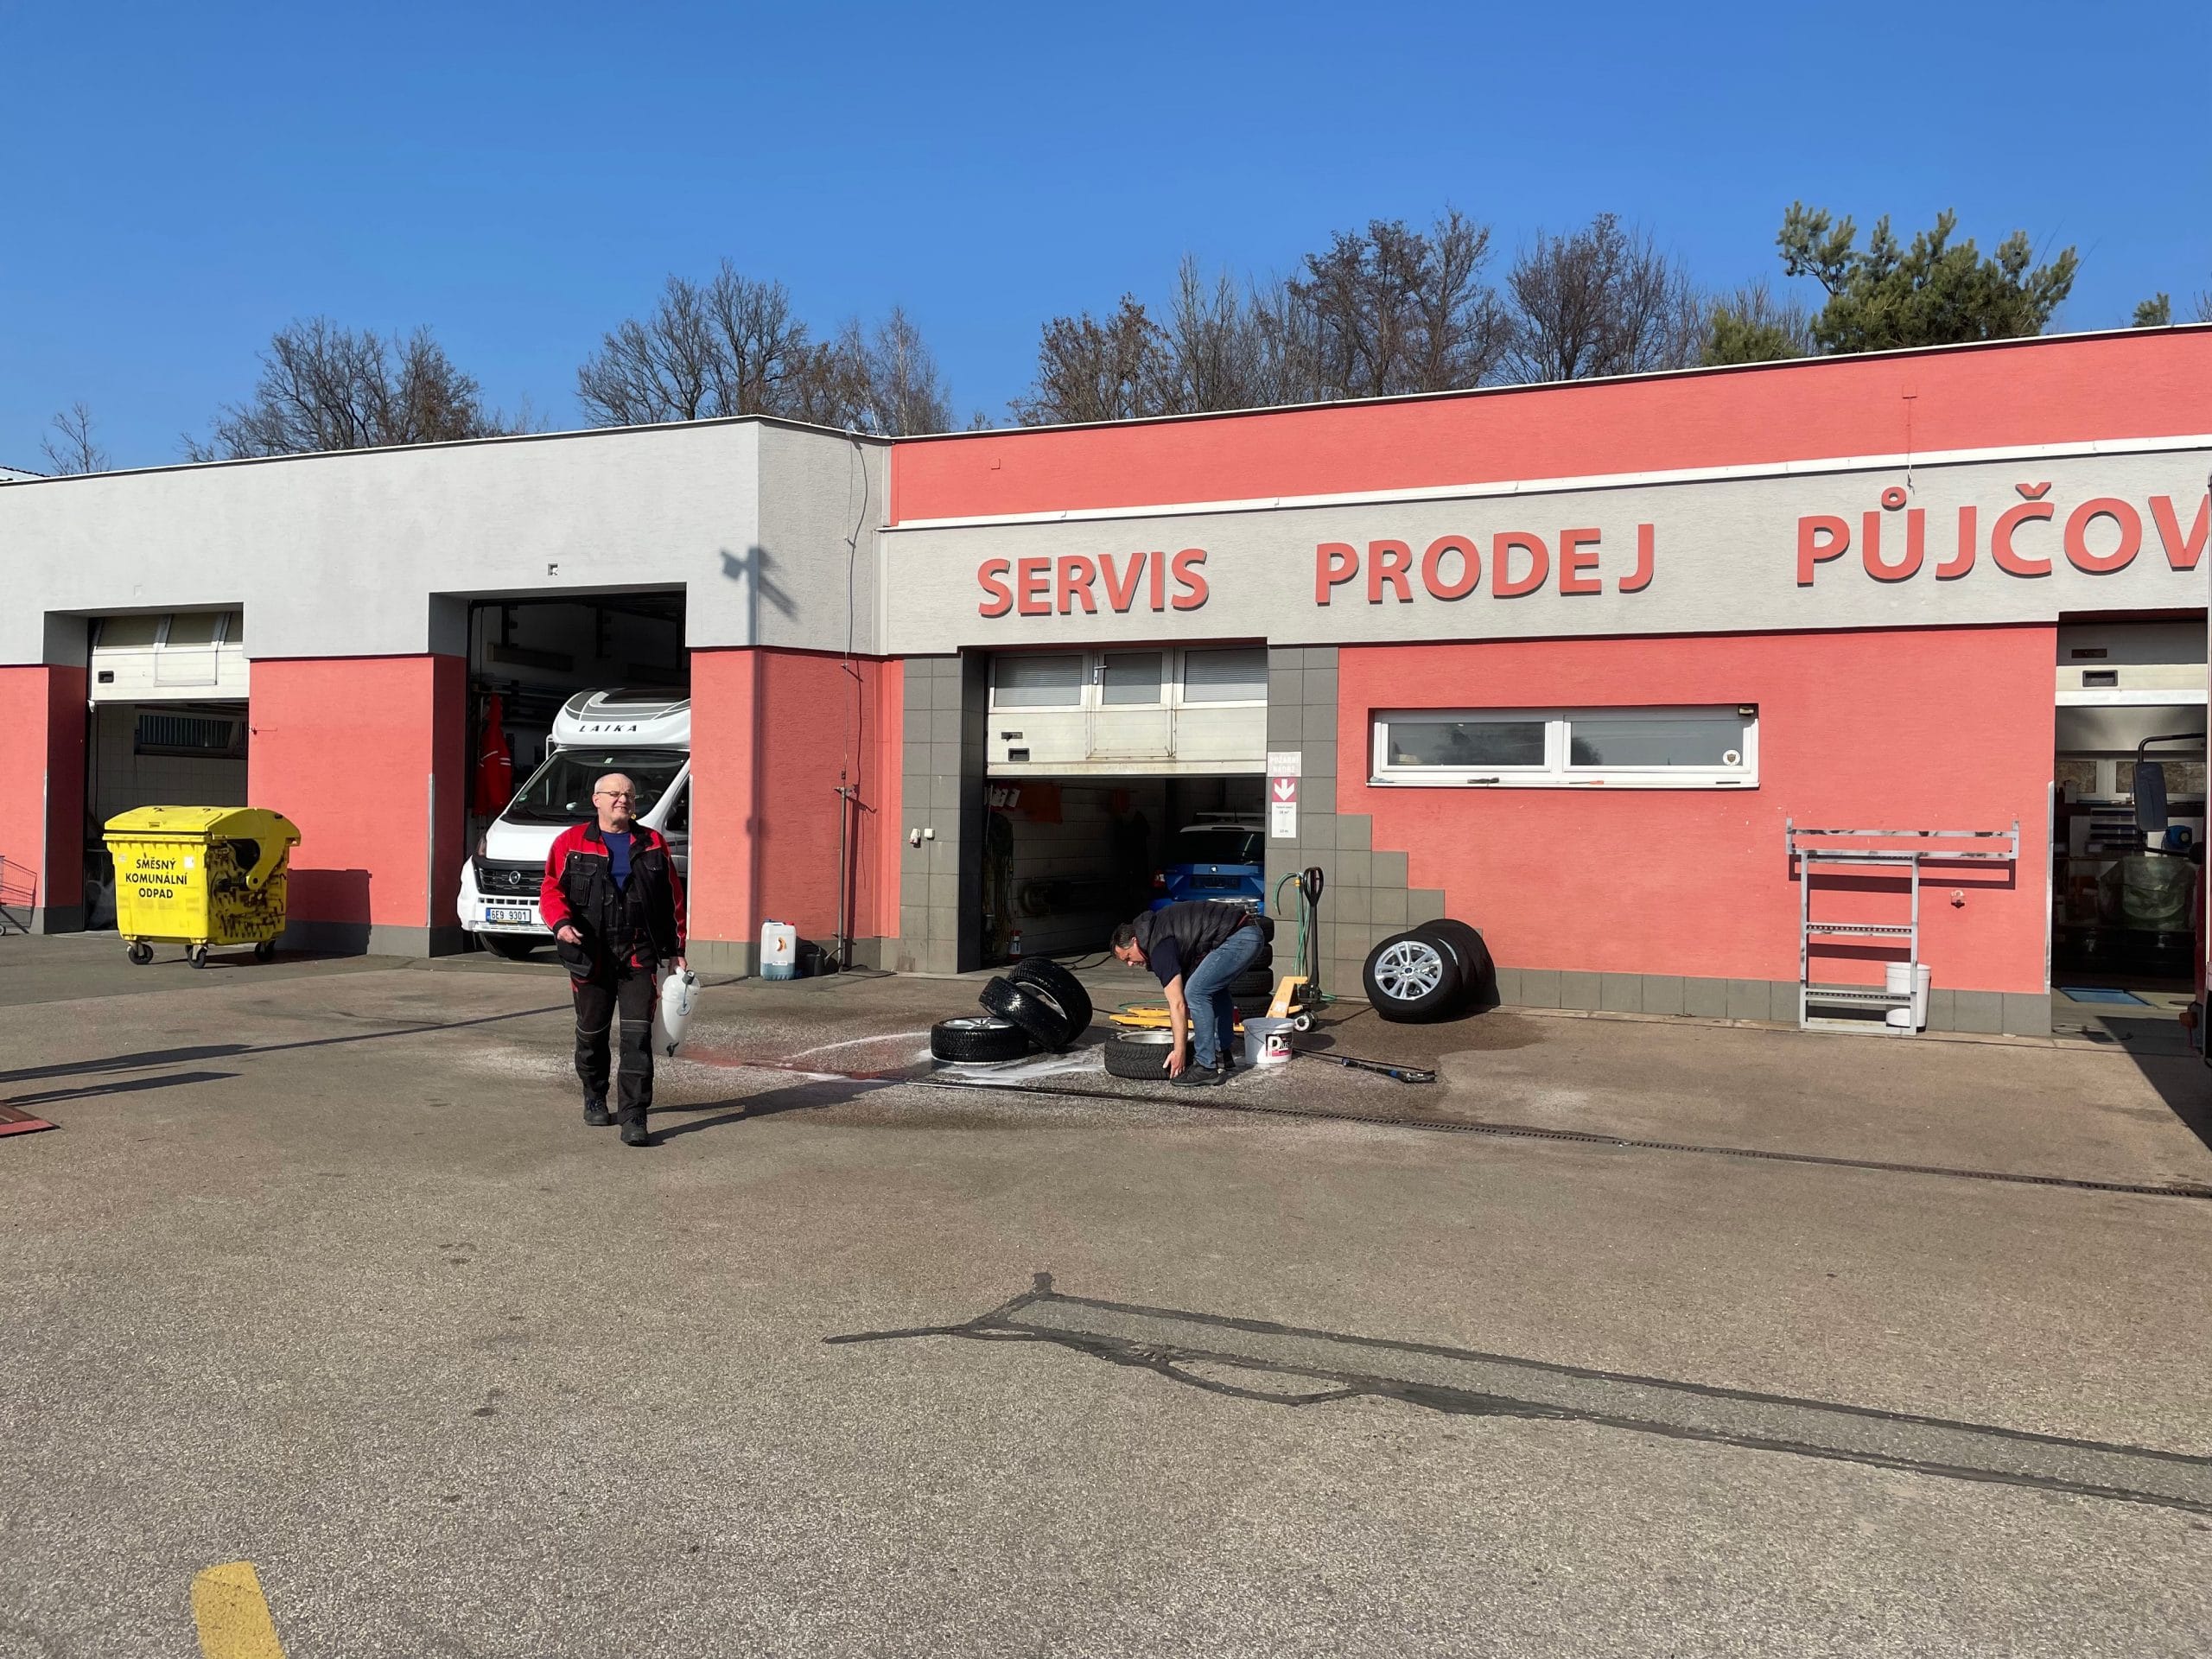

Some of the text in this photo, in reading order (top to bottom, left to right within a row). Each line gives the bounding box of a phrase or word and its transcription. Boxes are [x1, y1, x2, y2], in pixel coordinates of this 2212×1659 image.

[977, 548, 1209, 619] SERVIS
[1315, 523, 1656, 607] PRODEJ
[136, 856, 176, 870] SMĚSNÝ
[125, 871, 188, 886] KOMUNÁLNÍ
[138, 887, 174, 899] ODPAD
[509, 911, 526, 920] 9301
